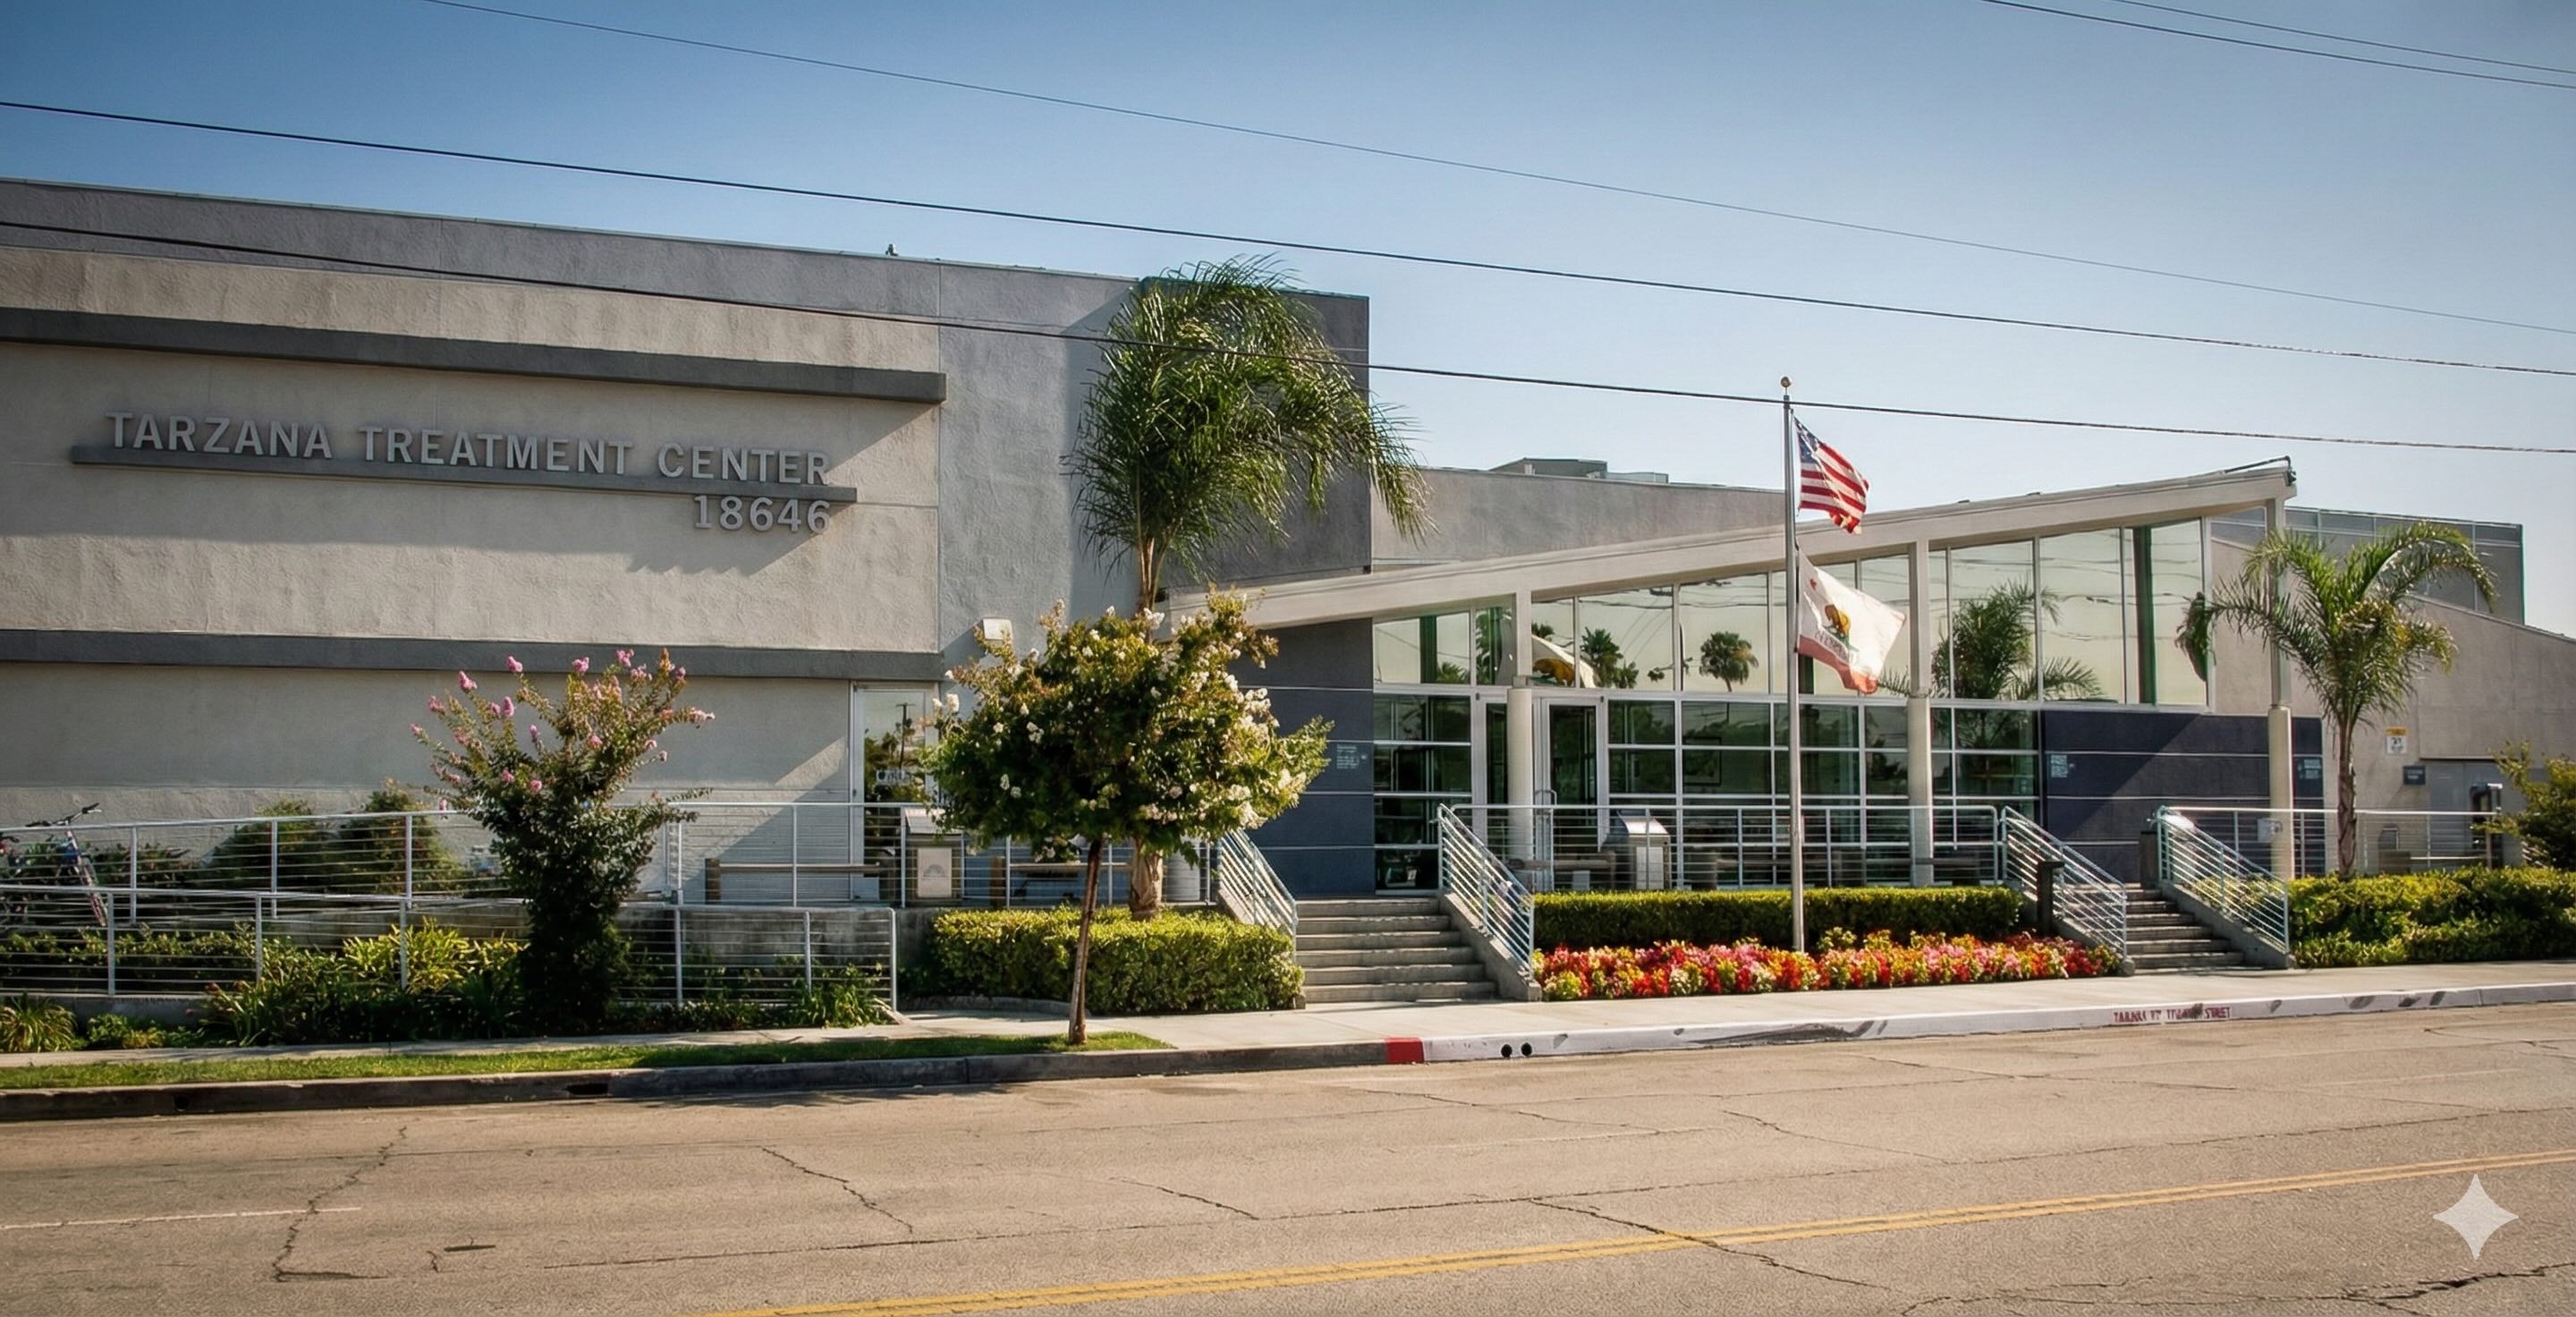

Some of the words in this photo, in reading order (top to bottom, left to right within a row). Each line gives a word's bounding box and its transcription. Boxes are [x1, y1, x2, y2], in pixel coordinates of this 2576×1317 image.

[106, 412, 333, 459] TARZANA
[358, 426, 633, 474] TREATMENT
[657, 443, 831, 485] CENTER
[693, 495, 831, 533] 18646
